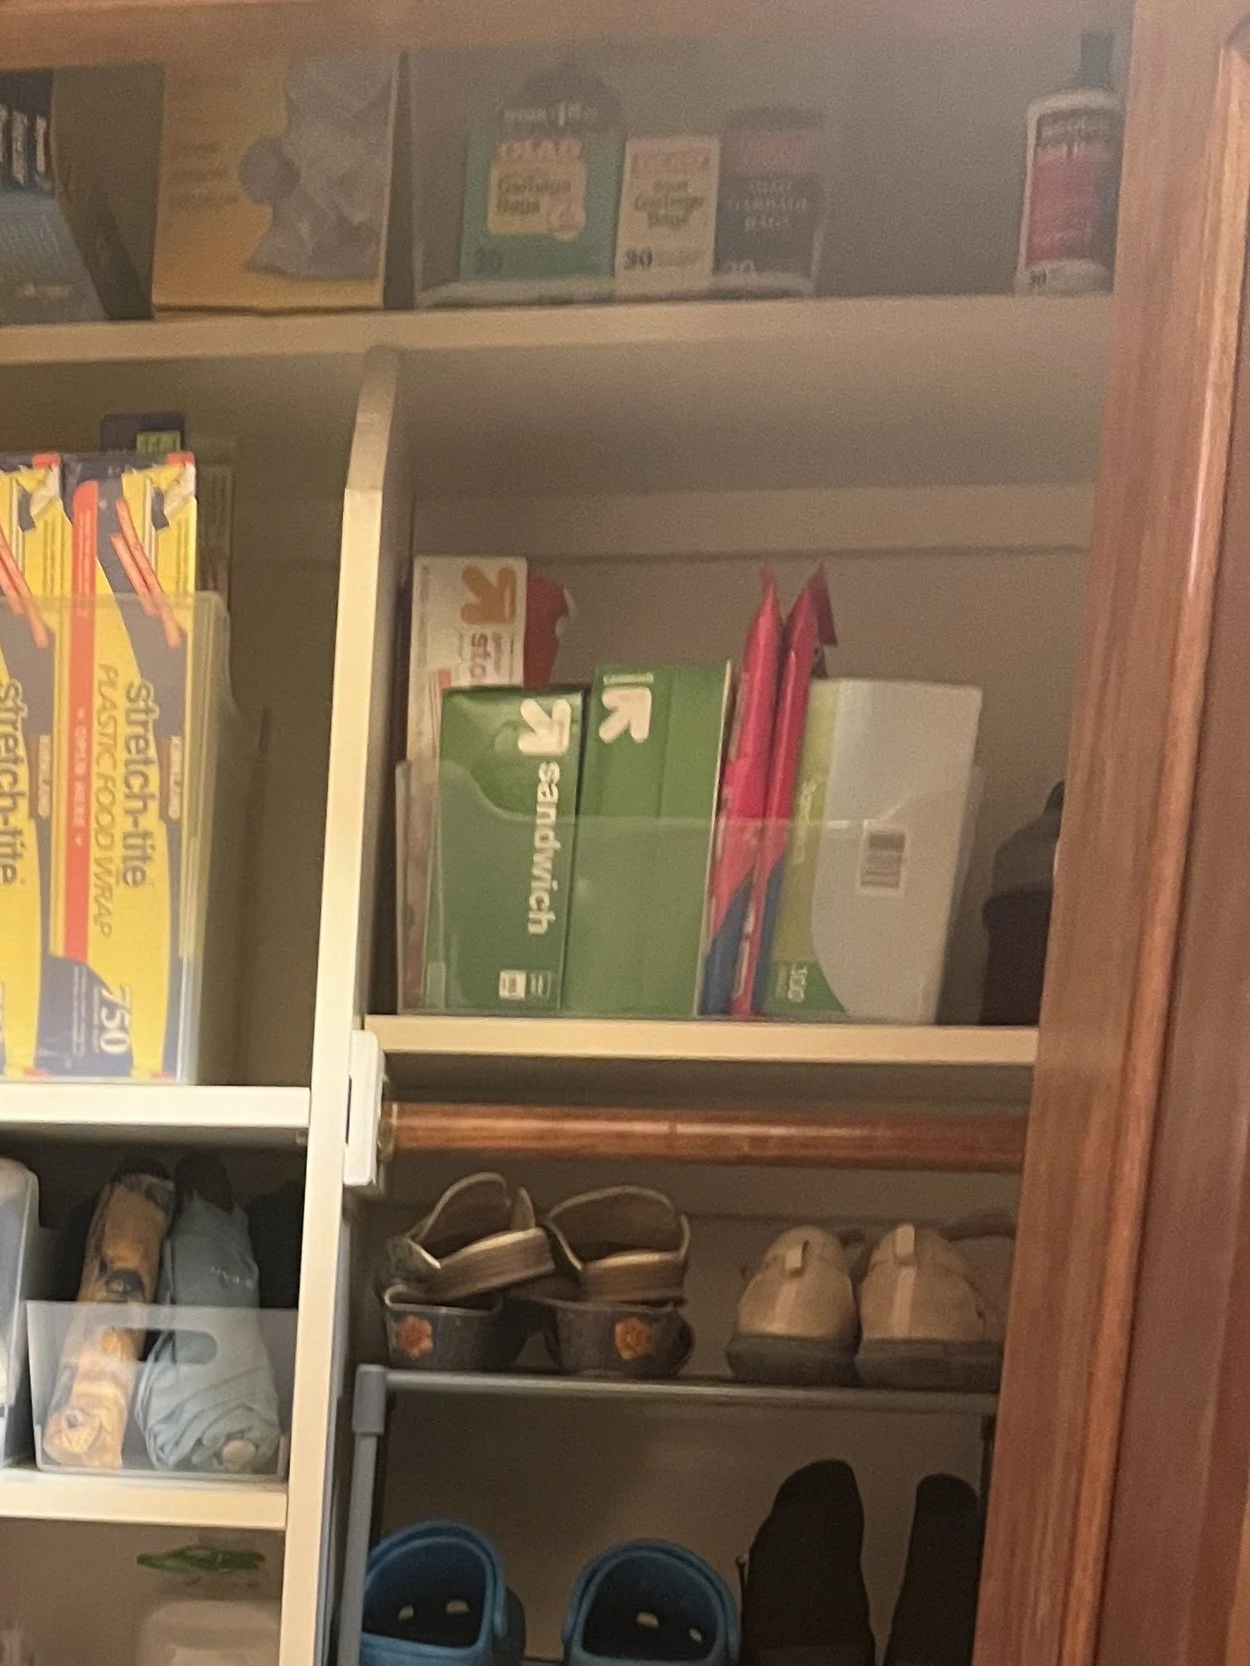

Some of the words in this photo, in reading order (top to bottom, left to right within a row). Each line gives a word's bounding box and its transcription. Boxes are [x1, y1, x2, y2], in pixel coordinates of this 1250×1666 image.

[96, 664, 119, 769] PLASTIC
[95, 772, 116, 854] FOOD
[122, 679, 160, 888] stretch-tite
[527, 761, 561, 935] sandwich
[93, 857, 115, 938] WRAP
[100, 984, 131, 1056] 750
